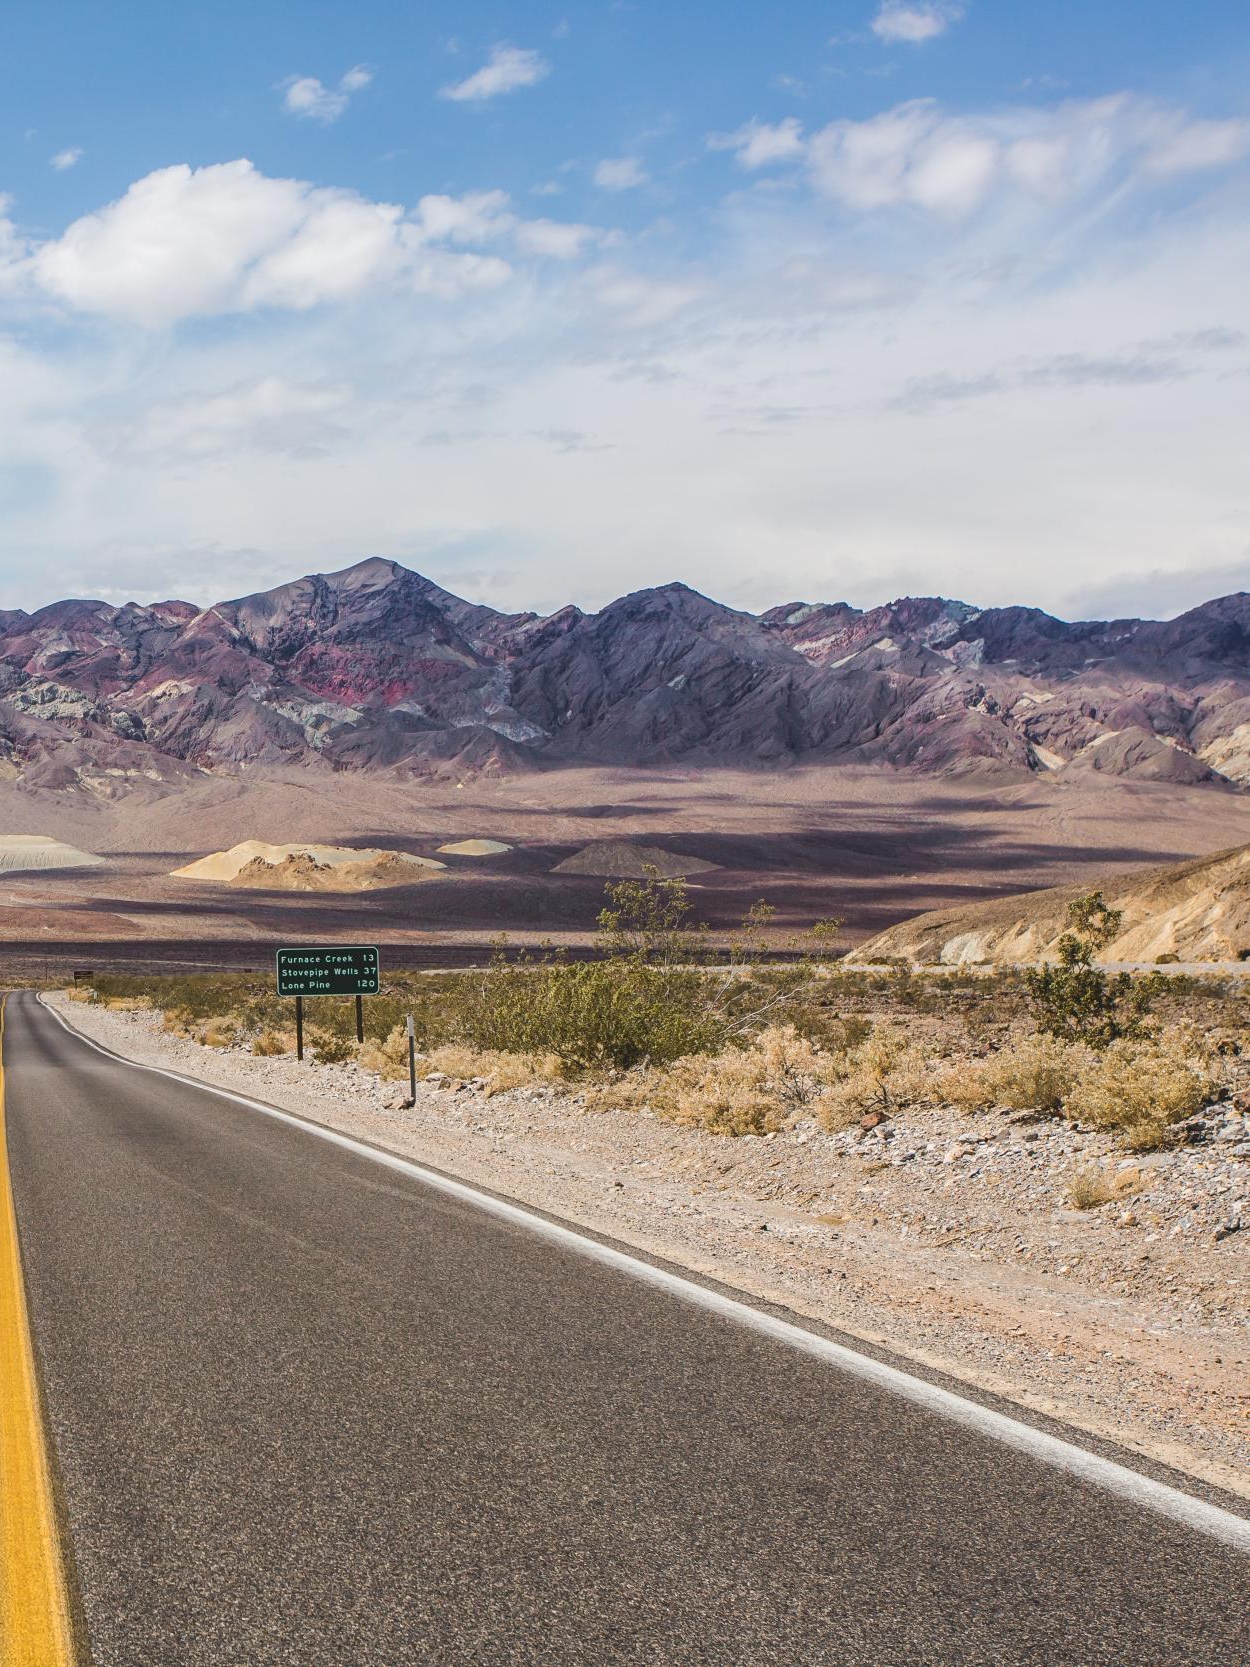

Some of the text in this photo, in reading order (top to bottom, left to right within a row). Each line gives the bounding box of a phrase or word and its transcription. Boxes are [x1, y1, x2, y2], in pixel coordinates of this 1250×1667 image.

[281, 954, 374, 964] Furnace Creek 13
[282, 967, 376, 977] Stovepipe Wells 37
[282, 982, 305, 990] Lone
[309, 981, 331, 989] Pine
